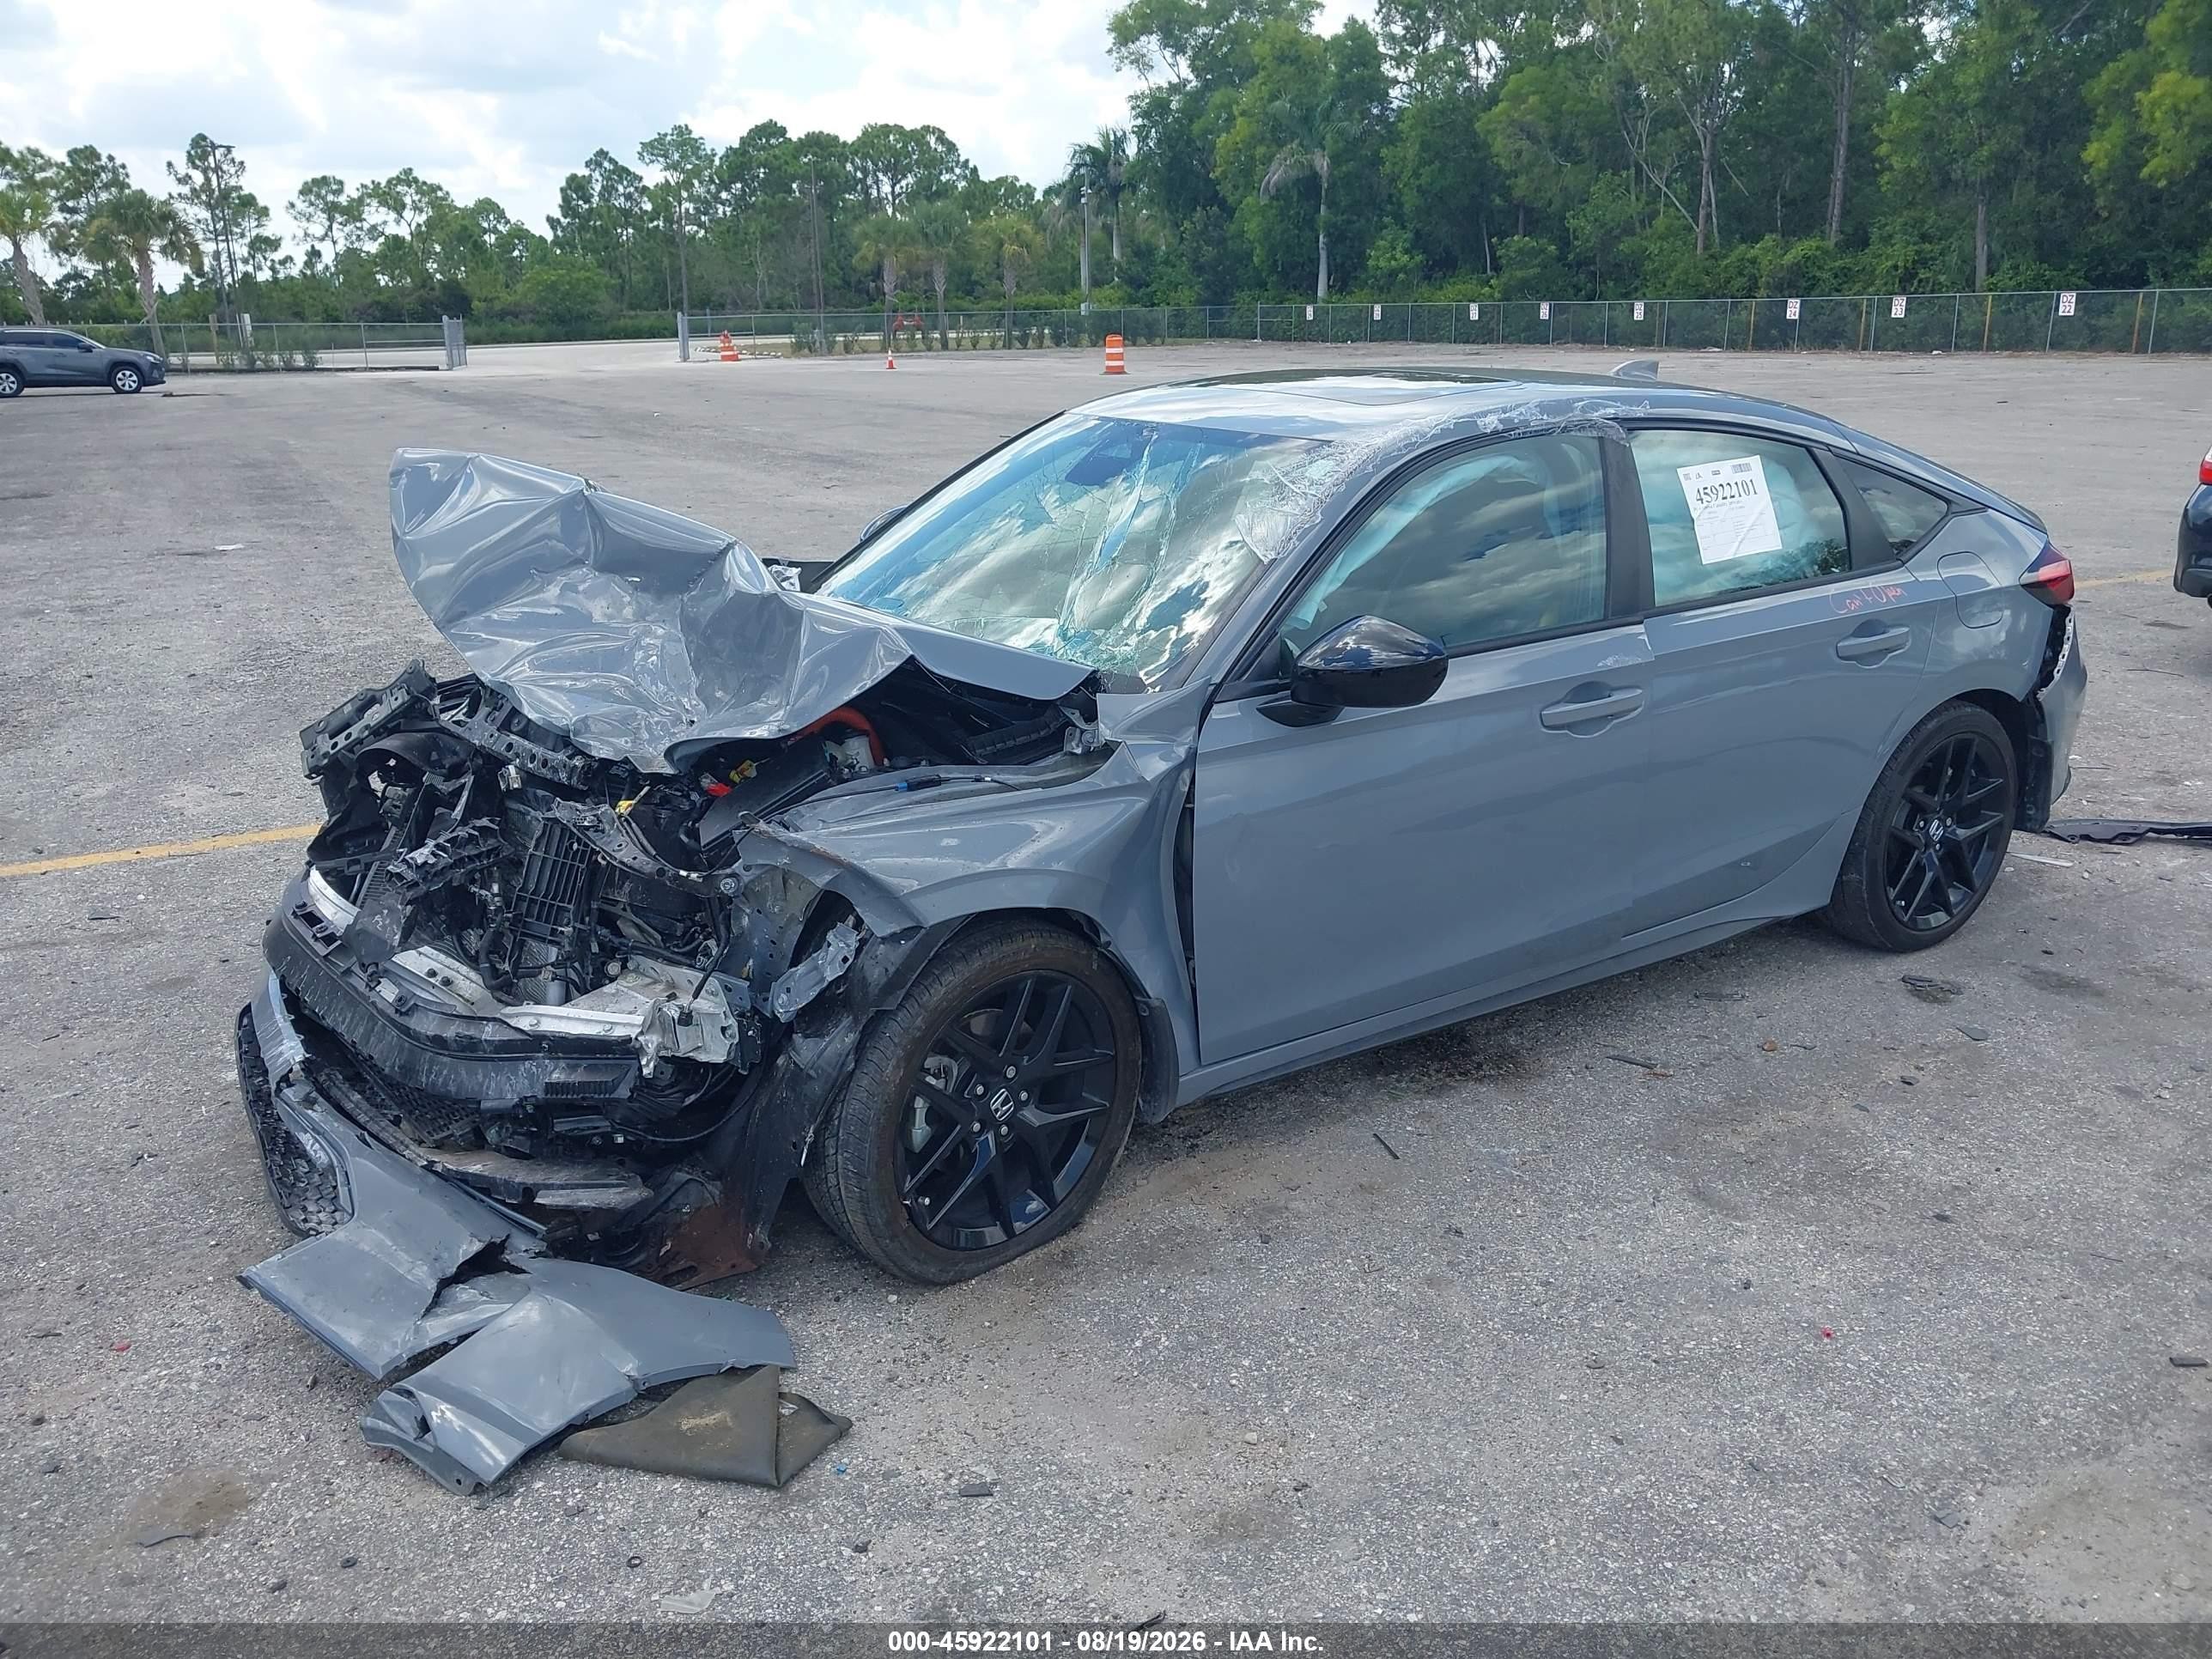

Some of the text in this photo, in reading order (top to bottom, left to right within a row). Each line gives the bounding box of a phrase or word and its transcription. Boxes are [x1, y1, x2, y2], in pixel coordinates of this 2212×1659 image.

[1893, 298, 1905, 307] DZ
[2062, 295, 2075, 304] DZ
[1788, 301, 1798, 309] DZ
[2061, 305, 2072, 313] 22
[1893, 307, 1903, 316] 23
[1695, 478, 1758, 504] 45922101
